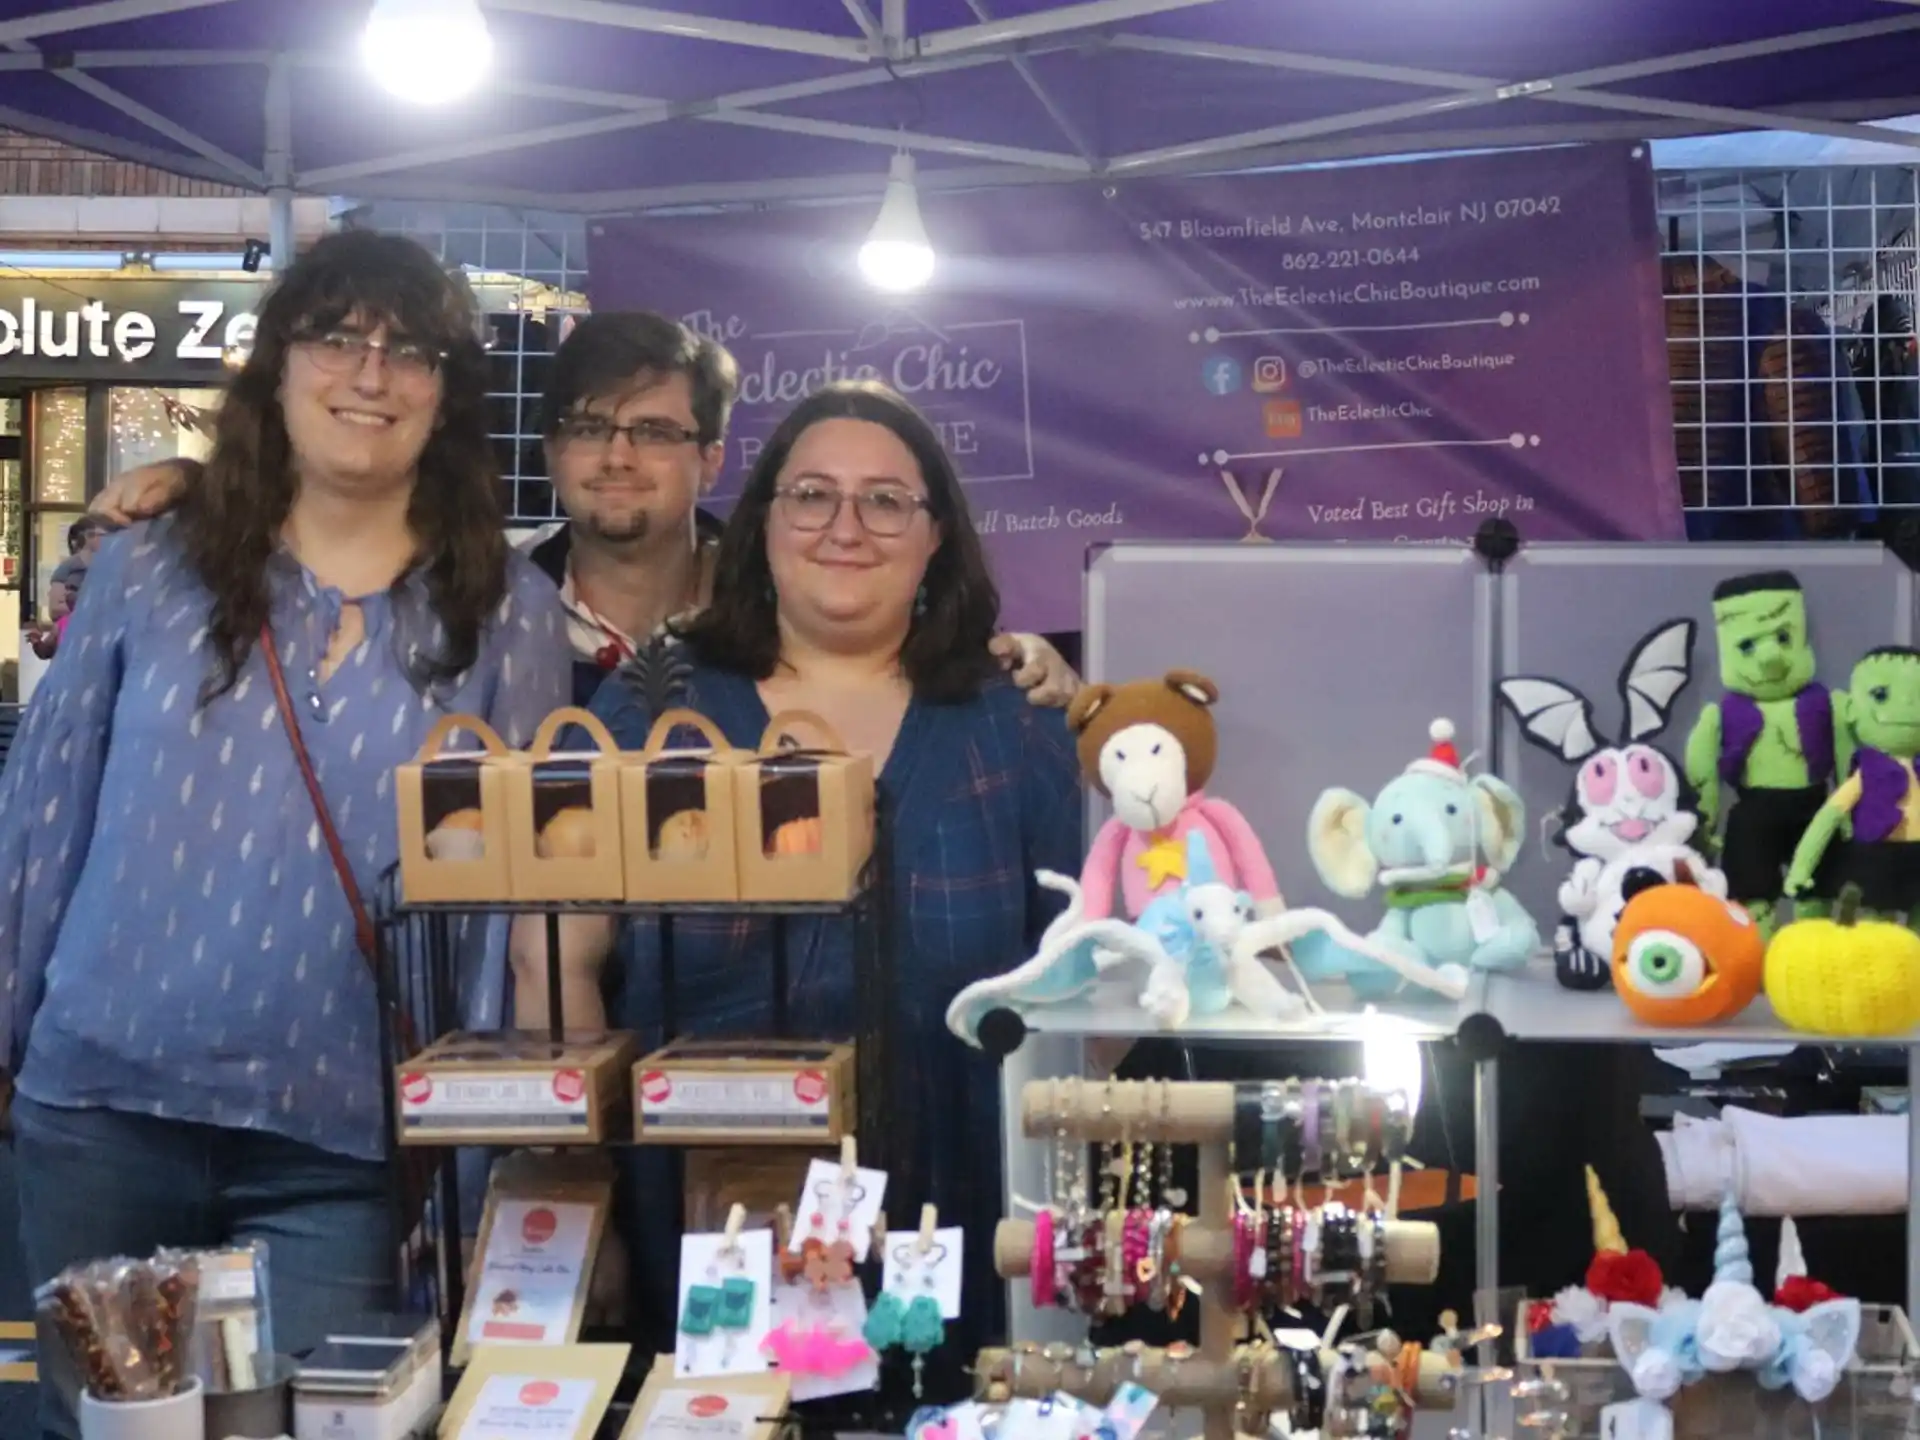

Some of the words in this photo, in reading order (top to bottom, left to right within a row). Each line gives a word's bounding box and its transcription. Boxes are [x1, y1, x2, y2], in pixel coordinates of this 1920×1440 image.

[1140, 221, 1172, 240] 547
[1180, 215, 1291, 239] Bloomfield
[1352, 206, 1453, 231] Montclair
[1460, 201, 1487, 224] NJ
[1494, 196, 1562, 219] 07042
[1282, 246, 1420, 270] 862-221-0644
[1174, 275, 1541, 310] www.TheEclecticChicBoutique.com
[683, 309, 747, 345] The
[734, 350, 882, 404] clectic
[892, 346, 1001, 393] Chic
[1299, 353, 1515, 378] @TheEclecticChicBoutique
[1308, 401, 1433, 422] TheEclecticChic
[1004, 505, 1060, 533] Batch
[1066, 501, 1123, 528] Goods
[1307, 498, 1365, 524] Voted
[1372, 500, 1409, 520] Best
[1416, 490, 1457, 522] Gift
[1463, 489, 1510, 518] Shop
[1516, 494, 1535, 511] in
